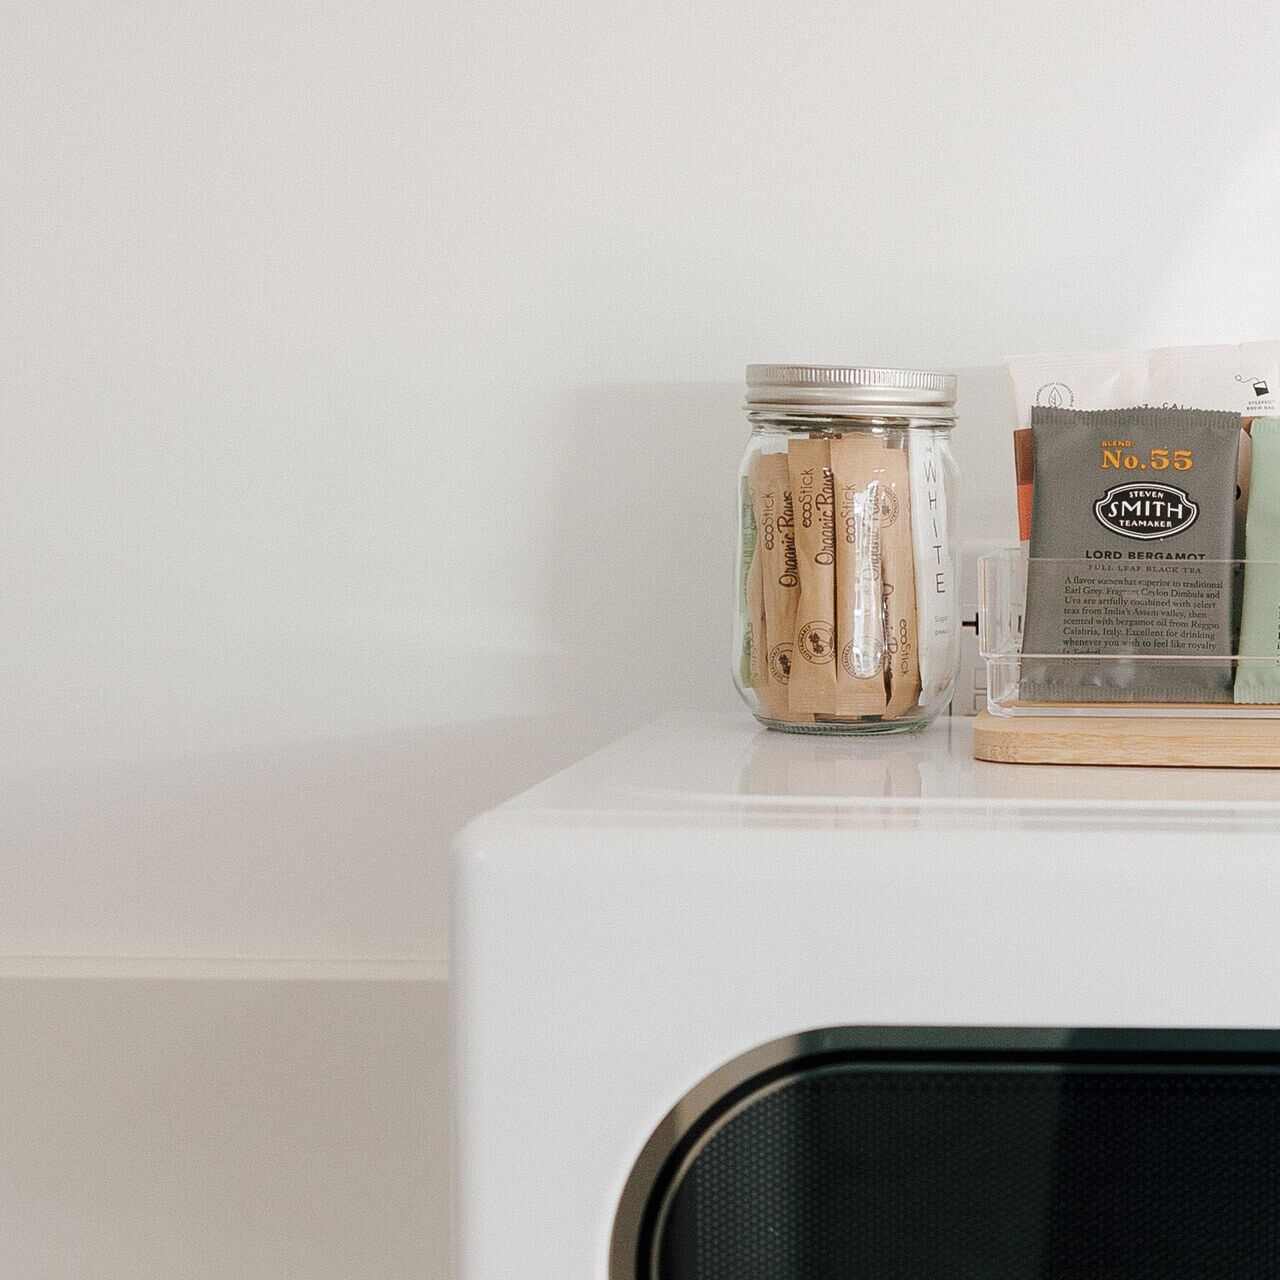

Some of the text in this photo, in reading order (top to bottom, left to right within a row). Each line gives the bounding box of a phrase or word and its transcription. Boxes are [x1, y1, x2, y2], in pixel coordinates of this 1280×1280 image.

[1102, 440, 1134, 448] BLEND:
[798, 468, 814, 528] ecoStick
[1128, 490, 1164, 499] STEVEN
[840, 484, 856, 544] ecoStick
[1108, 500, 1183, 520] SMITH
[762, 492, 774, 550] ecoStick
[924, 460, 946, 594] WHITE
[1119, 520, 1172, 528] TEAMAKER
[1086, 550, 1206, 560] LORD BERGAMOT
[1074, 576, 1095, 584] flavor
[1098, 578, 1136, 586] somewhat
[1182, 580, 1223, 588] traditional
[1082, 606, 1102, 615] from
[1132, 608, 1159, 616] Assam
[1188, 610, 1207, 618] then
[1096, 618, 1114, 626] with
[1116, 618, 1154, 627] bergamot
[1170, 619, 1189, 628] from
[899, 618, 911, 676] ecoStick
